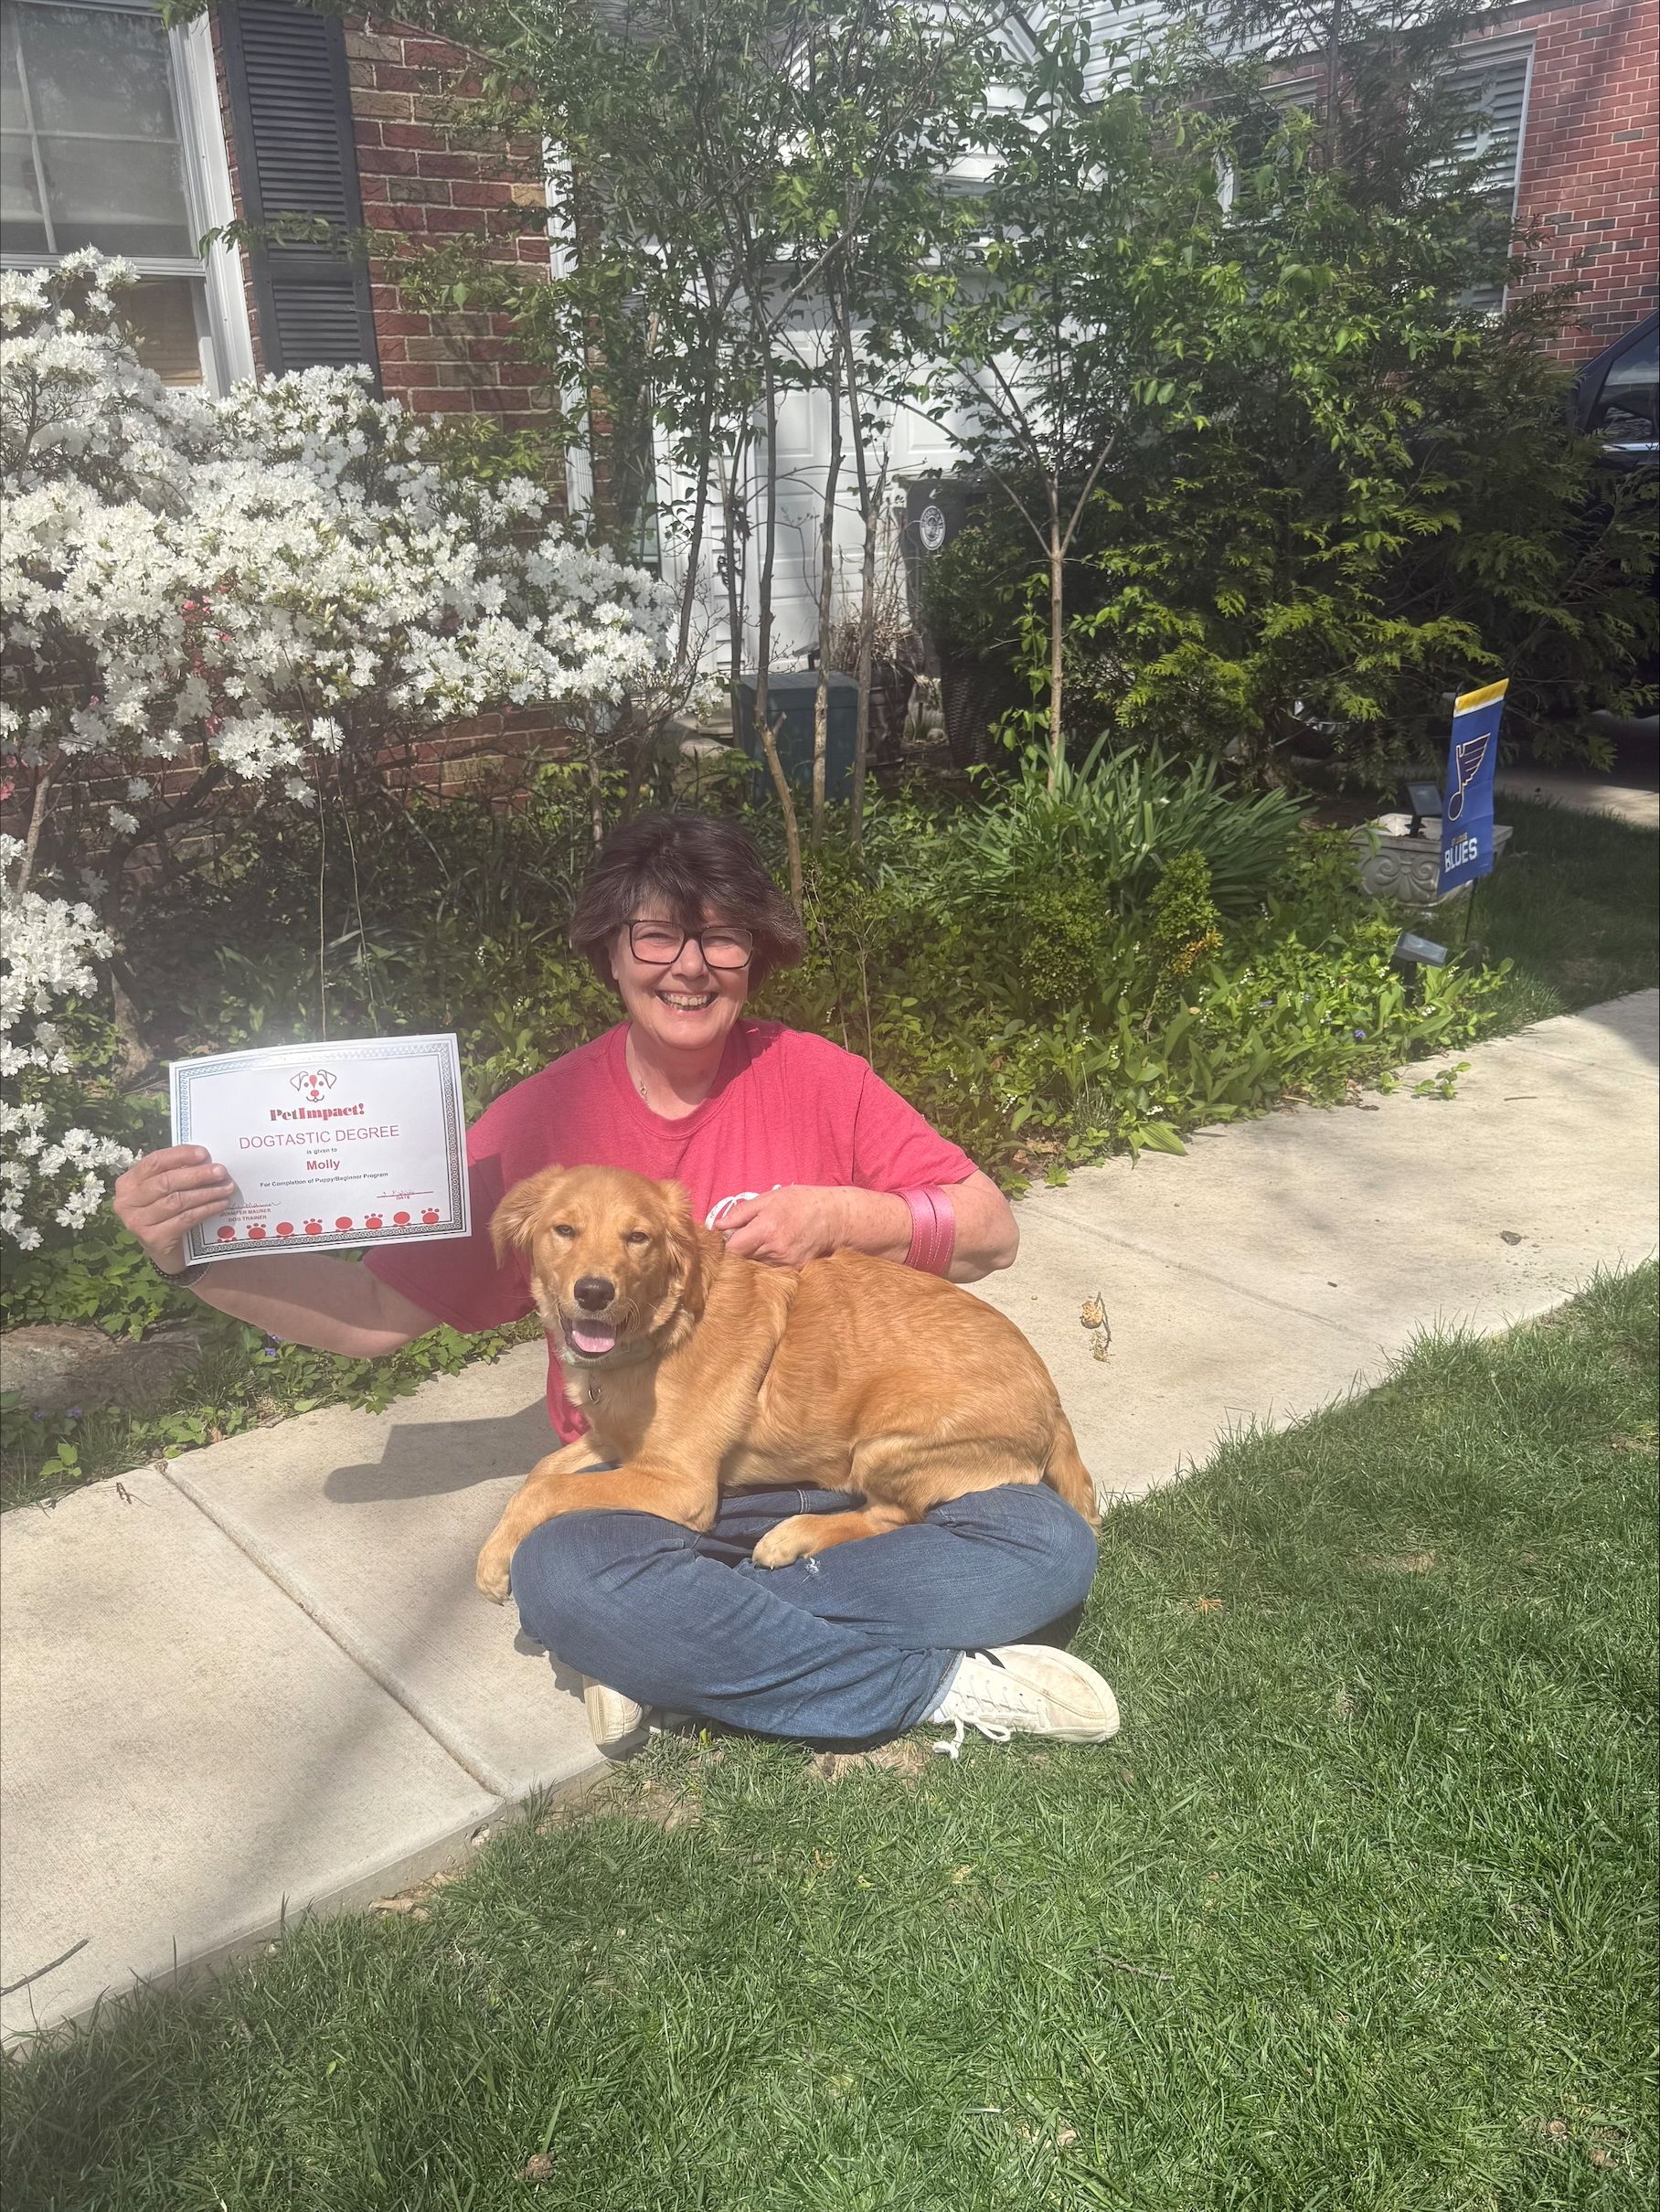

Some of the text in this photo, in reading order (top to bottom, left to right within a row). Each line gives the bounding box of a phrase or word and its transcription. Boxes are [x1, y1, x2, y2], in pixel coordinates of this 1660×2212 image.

[1444, 837, 1477, 873] BLUES
[270, 1102, 365, 1122] PetImpact!
[239, 1125, 399, 1149] DOGTASTIC DEGREE
[306, 1159, 340, 1171] Molly
[271, 1178, 306, 1187] Completion
[315, 1174, 362, 1184] Puppy/Beginner
[363, 1171, 388, 1180] Program
